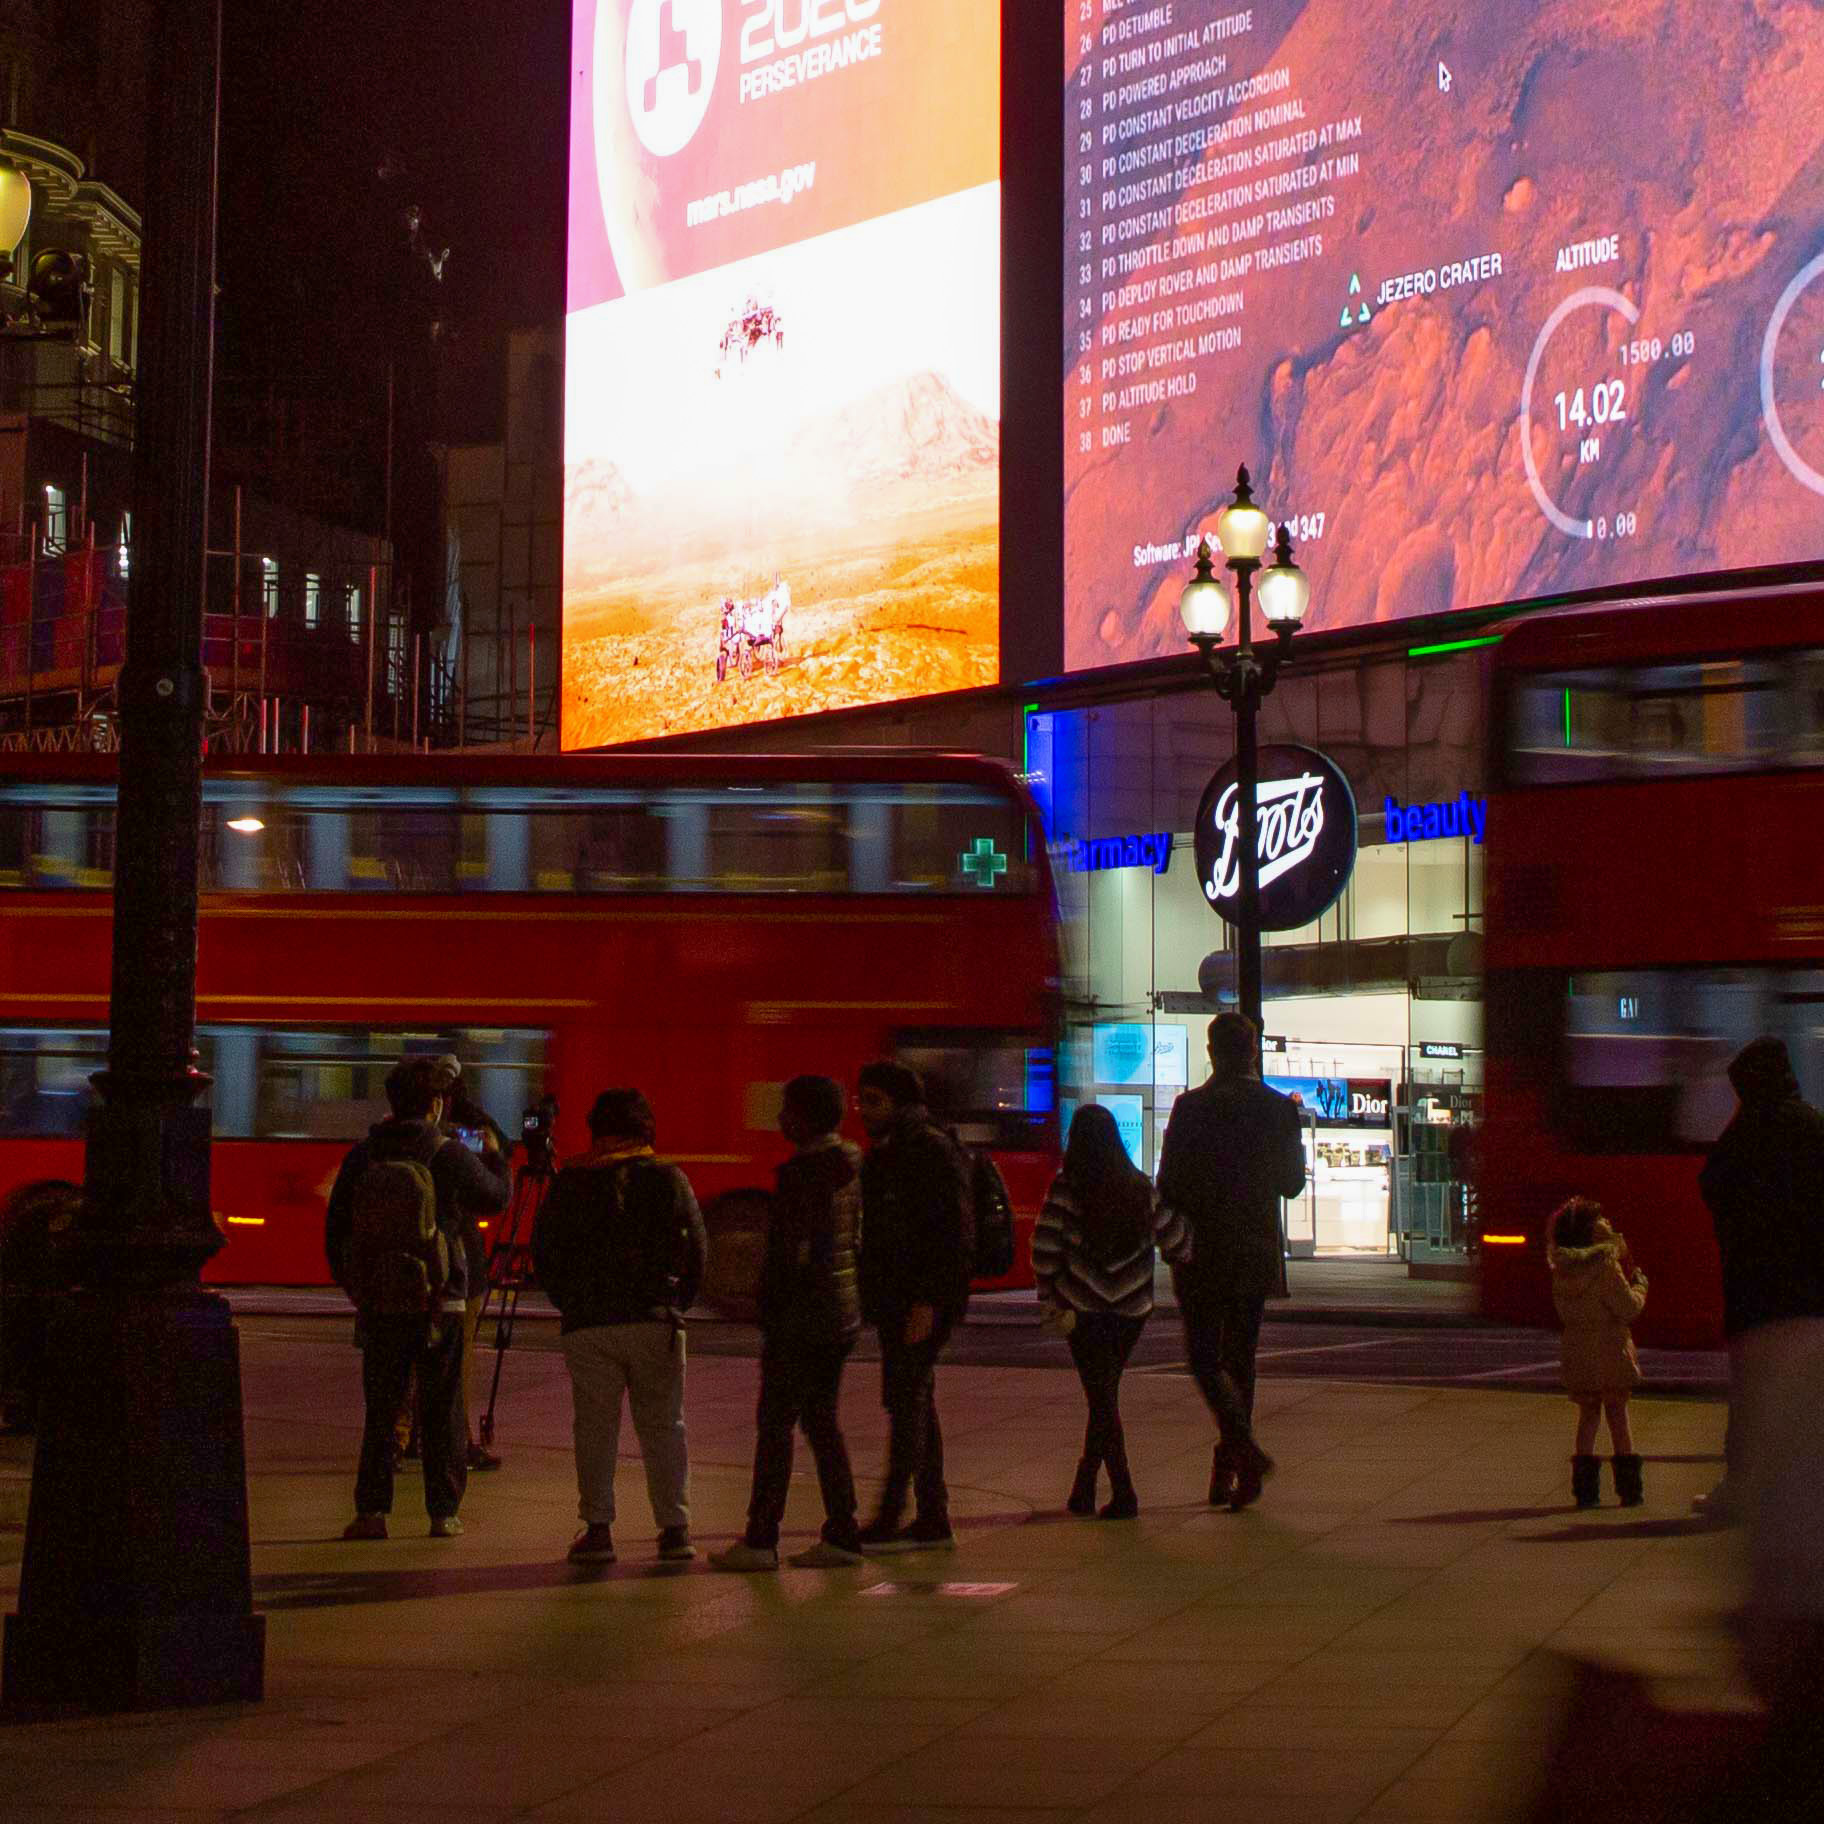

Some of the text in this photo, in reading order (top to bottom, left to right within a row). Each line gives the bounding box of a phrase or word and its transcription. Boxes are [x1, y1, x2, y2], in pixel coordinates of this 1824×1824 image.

[740, 24, 882, 104] PERSEVERANCE
[1080, 68, 1290, 152] 29 PD CONSTANT VELOCITY ACCORDION
[1556, 234, 1620, 274] ALTITUDE
[1376, 253, 1504, 305] JEZERO CRATER
[1080, 292, 1244, 352] 35 PD READY FOR TOUCHDOWN
[1619, 331, 1695, 366] 1500.00
[1554, 381, 1626, 432] 14.02
[1080, 422, 1131, 453] 38 DONE
[1579, 438, 1601, 464] KM
[1300, 512, 1325, 542] 347
[1596, 512, 1637, 539] 0.00
[1133, 541, 1181, 566] Software:
[1385, 789, 1487, 844] beauty
[1263, 1039, 1278, 1052] ior
[1426, 1044, 1459, 1056] CHANEL
[1352, 1094, 1388, 1114] Dior
[1450, 1095, 1473, 1108] Dior
